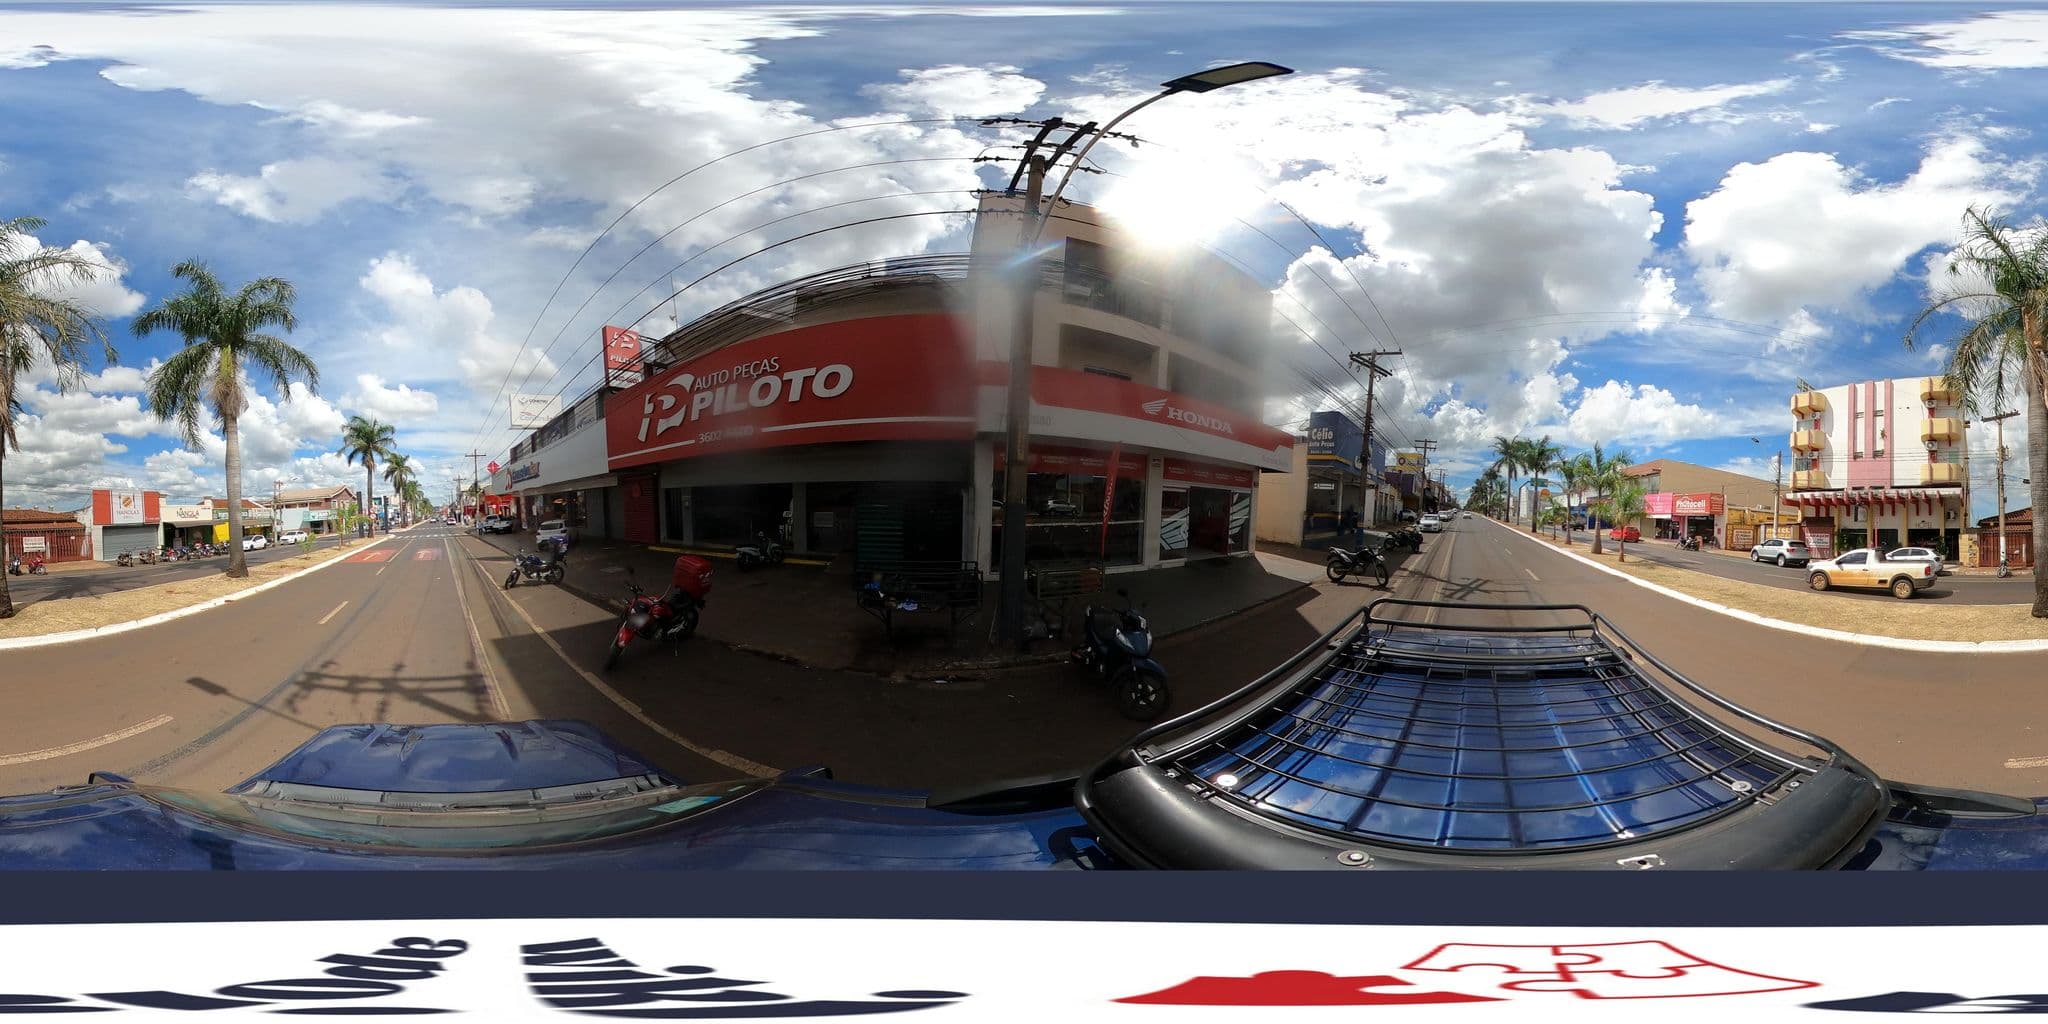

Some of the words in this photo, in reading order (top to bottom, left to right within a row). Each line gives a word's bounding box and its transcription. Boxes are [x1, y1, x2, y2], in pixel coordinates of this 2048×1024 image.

[694, 369, 729, 391] AUTO
[733, 356, 780, 379] PEÇAS
[690, 363, 854, 422] PILOTO
[1167, 406, 1233, 435] HONDA
[1311, 427, 1334, 440] Célio
